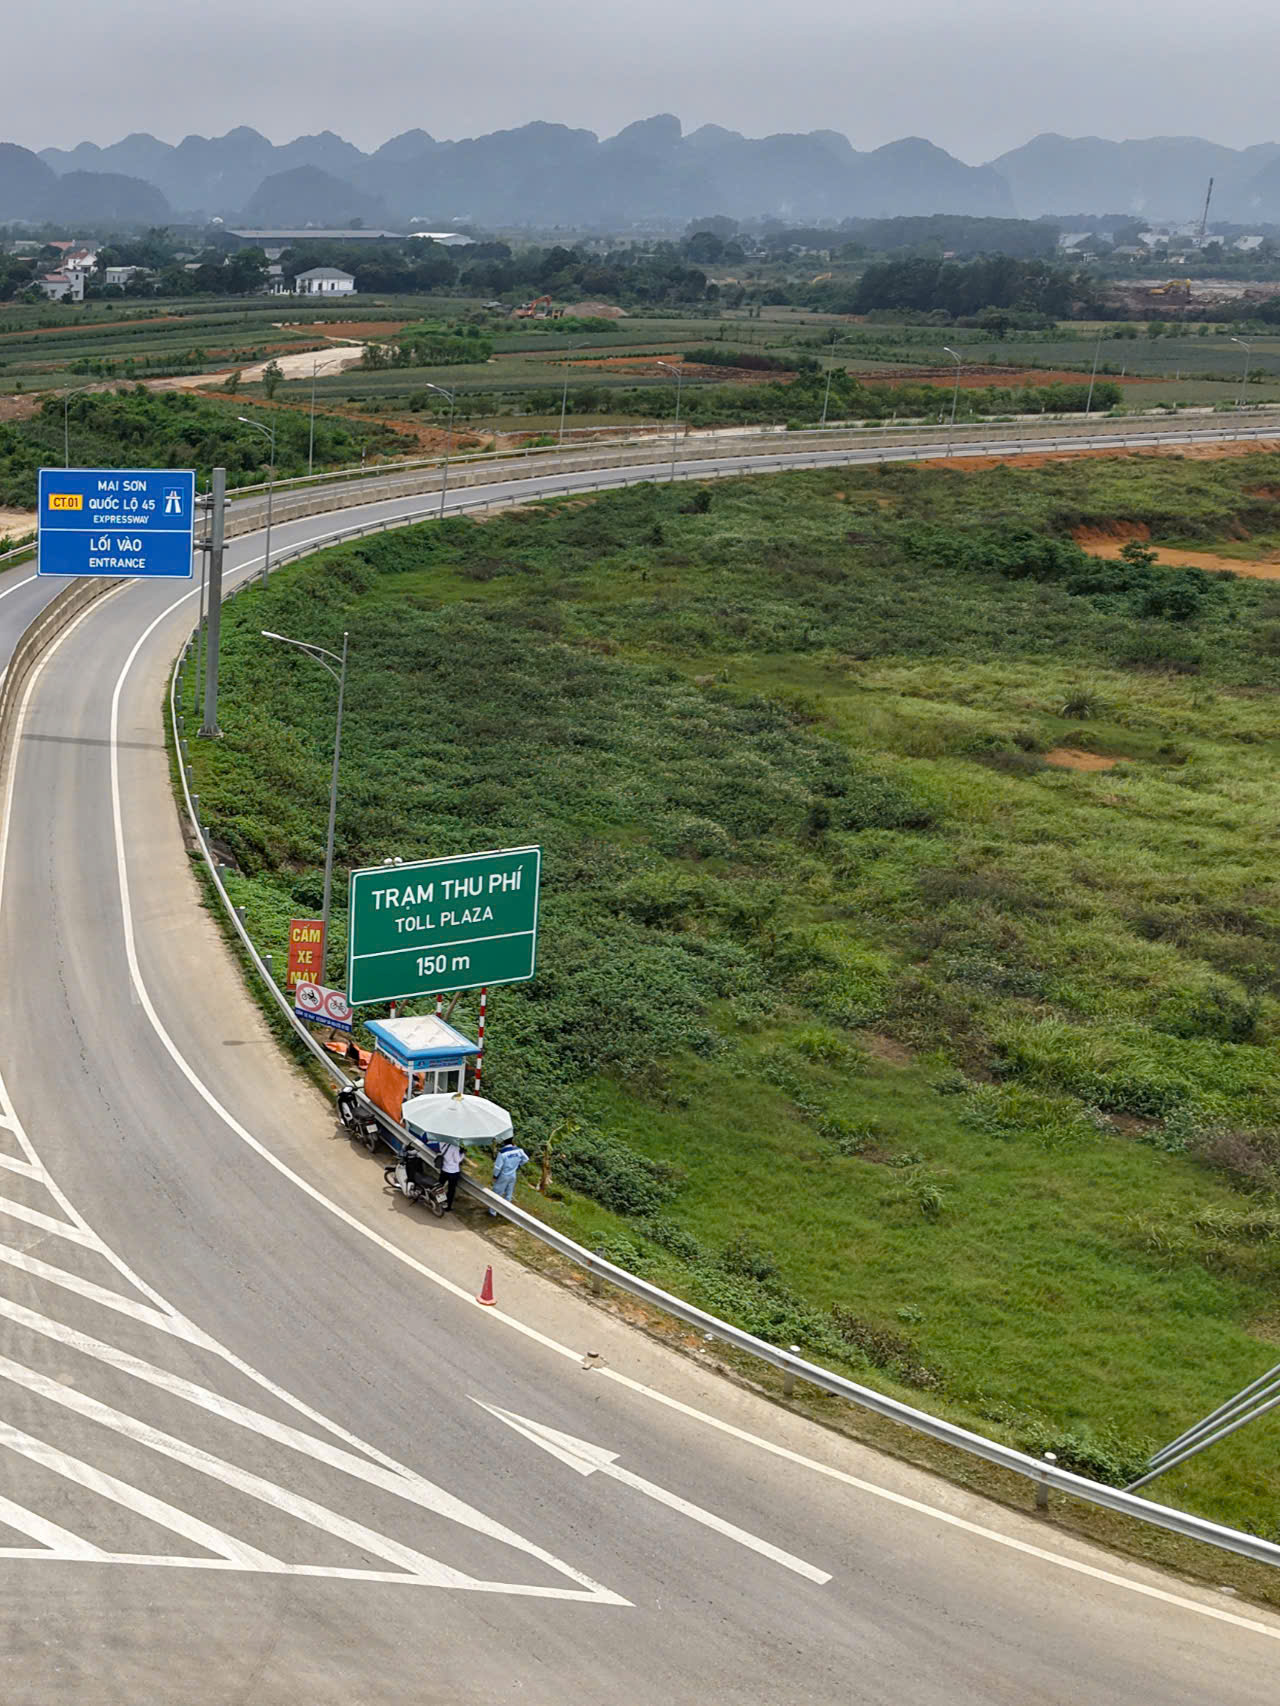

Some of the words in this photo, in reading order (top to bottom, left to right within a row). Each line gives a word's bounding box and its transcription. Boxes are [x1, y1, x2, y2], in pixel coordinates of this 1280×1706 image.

[98, 480, 119, 492] MAI
[123, 479, 147, 492] SƠN
[53, 497, 79, 508] CT.01
[89, 494, 119, 510] QUỐC
[123, 498, 138, 512] LỘ
[141, 500, 156, 510] 45
[93, 515, 150, 524] EXPRESSWAY
[90, 534, 111, 551] LỐI
[117, 535, 143, 552] VÀO
[89, 557, 146, 569] ENTRANCE
[371, 883, 434, 911] TRẠM
[440, 876, 483, 900] THU
[488, 864, 524, 894] PHÍ
[395, 914, 436, 933] TOLL
[440, 906, 494, 928] PLAZA
[292, 924, 321, 943] CẤM
[297, 950, 313, 964] XE
[416, 954, 447, 977] 150
[451, 955, 470, 971] m
[290, 969, 318, 985] MÁY
